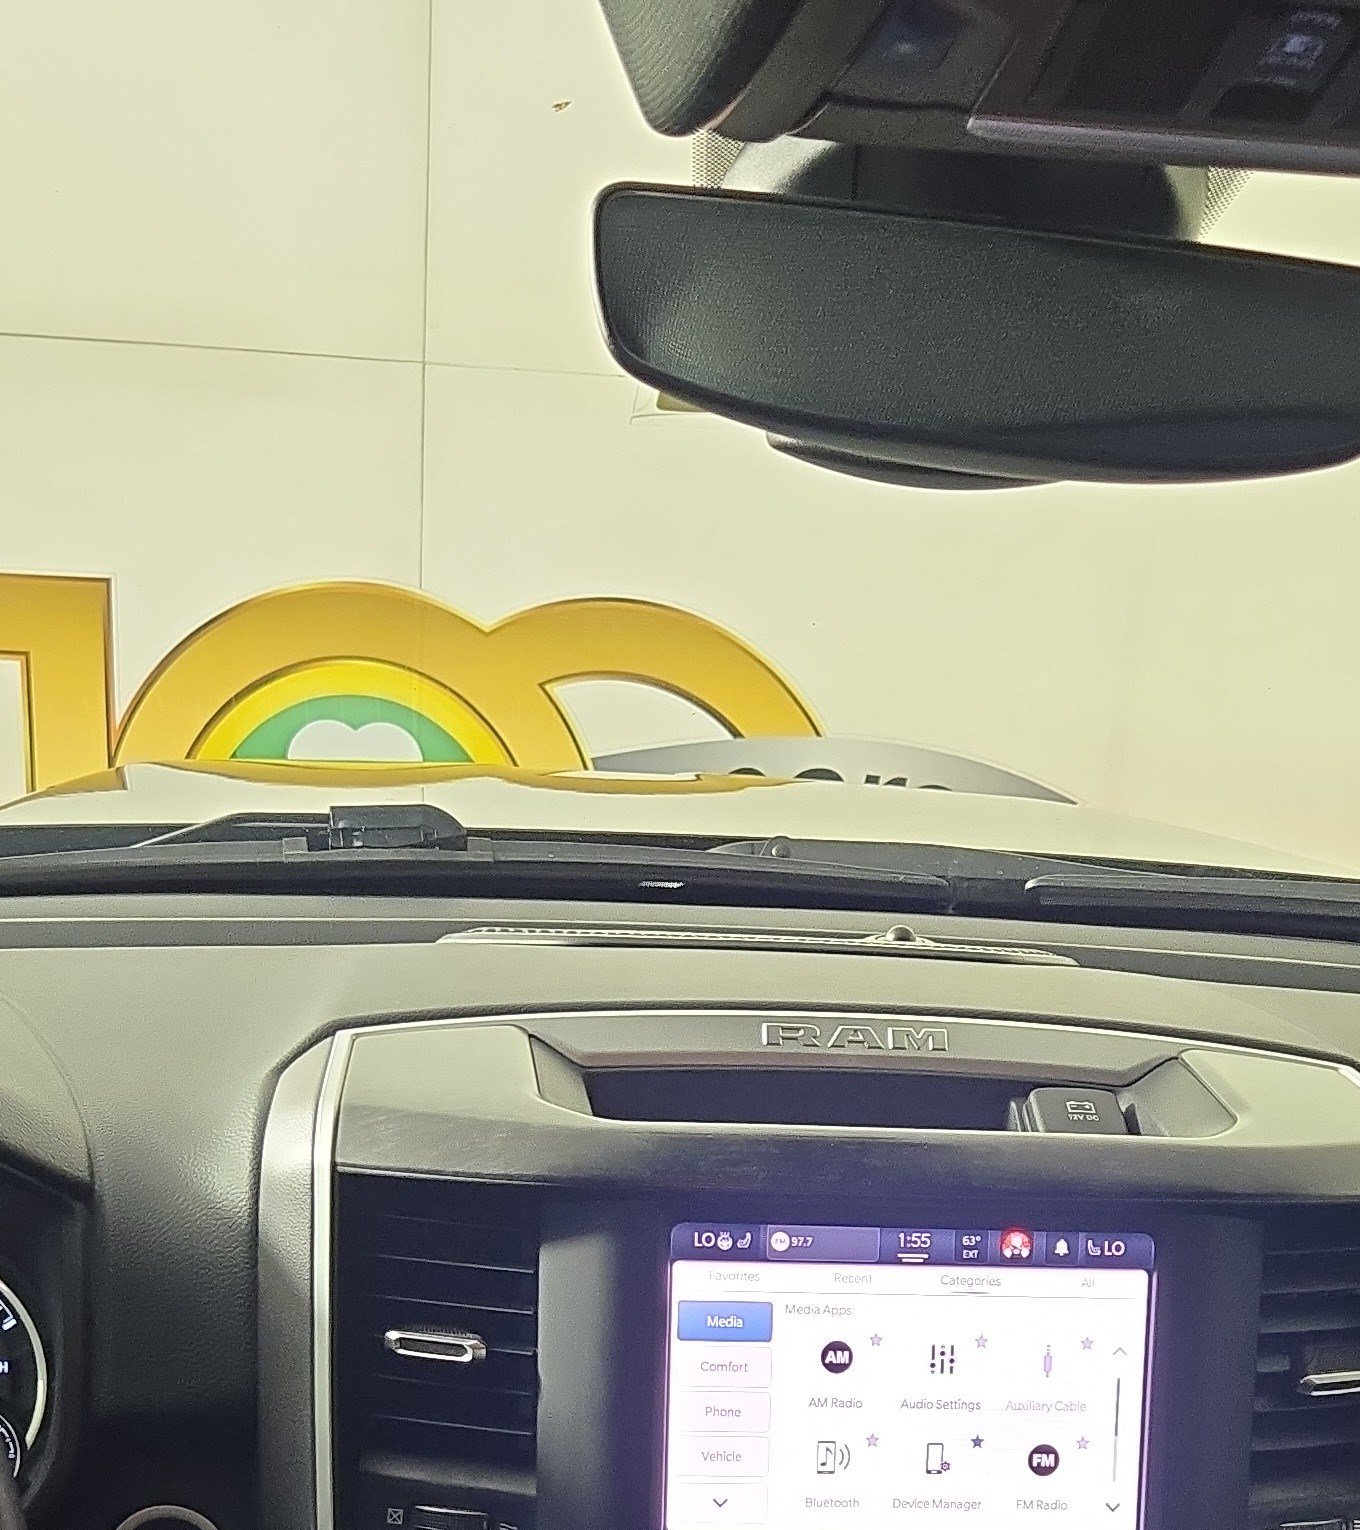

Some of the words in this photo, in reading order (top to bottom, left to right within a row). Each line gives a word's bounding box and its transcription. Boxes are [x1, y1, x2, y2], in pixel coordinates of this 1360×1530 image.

[761, 1022, 949, 1051] RAM
[1068, 1113, 1085, 1122] 12V
[693, 1231, 716, 1249] LO
[791, 1236, 814, 1247] 97.7
[897, 1232, 932, 1249] 1:55
[962, 1234, 982, 1247] 63°
[962, 1249, 980, 1260] EXT
[1103, 1240, 1126, 1256] LO
[709, 1270, 761, 1282] Favorites
[833, 1272, 873, 1285] Recent
[940, 1275, 1002, 1289] Categories
[1081, 1276, 1096, 1288] All
[785, 1304, 820, 1316] Media
[706, 1314, 744, 1329] Media
[824, 1350, 850, 1364] AM
[700, 1360, 749, 1374] Comfort
[808, 1397, 827, 1409] AM
[829, 1397, 863, 1410] Radio
[900, 1398, 934, 1410] Audio
[936, 1398, 981, 1414] Settings
[1005, 1400, 1052, 1414] Auxiliary
[1054, 1400, 1087, 1412] Cable
[704, 1406, 742, 1418] Phone
[701, 1450, 742, 1463] Vehicle
[1032, 1454, 1056, 1467] FM
[804, 1497, 860, 1510] Bluetooth
[892, 1497, 930, 1510] Device
[931, 1498, 982, 1513] Manager
[1016, 1499, 1035, 1511] FM
[1036, 1499, 1068, 1512] Radio
